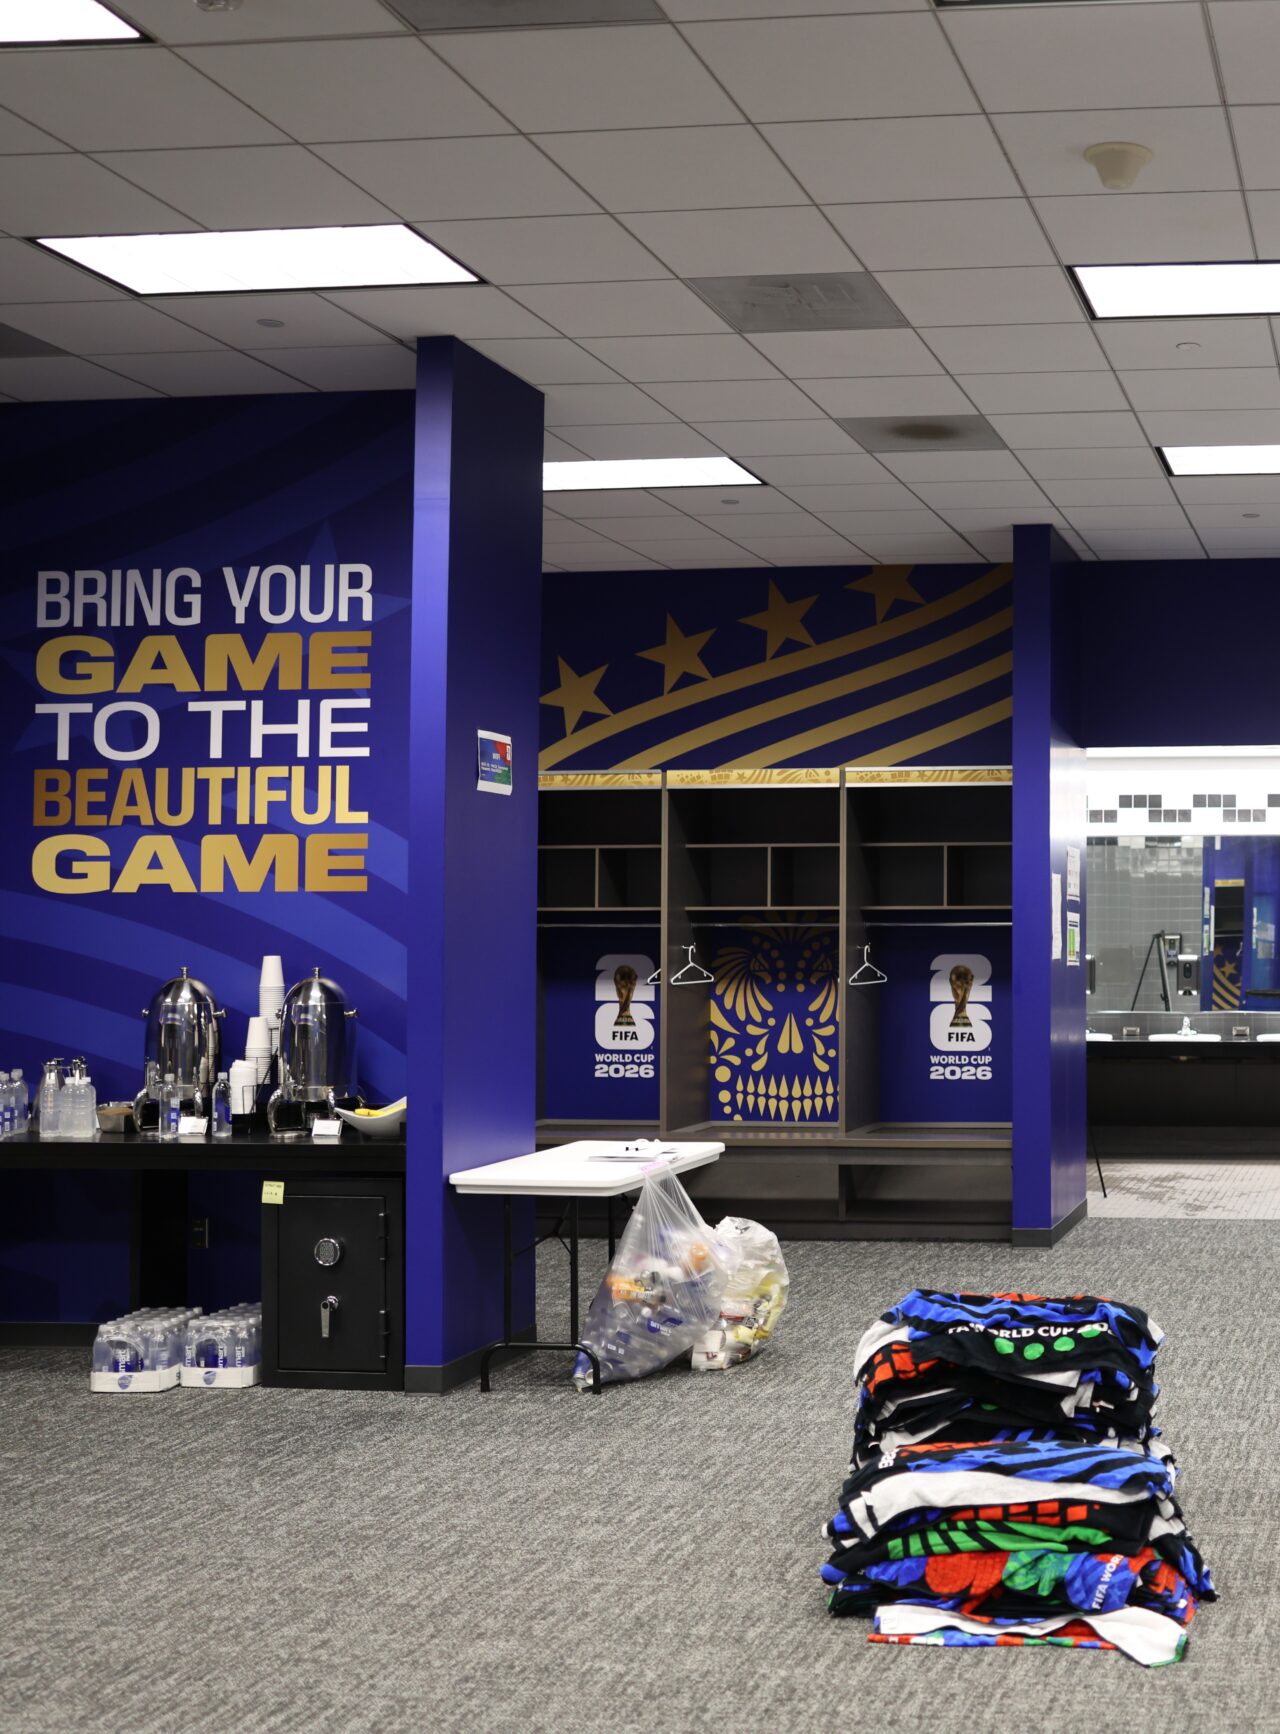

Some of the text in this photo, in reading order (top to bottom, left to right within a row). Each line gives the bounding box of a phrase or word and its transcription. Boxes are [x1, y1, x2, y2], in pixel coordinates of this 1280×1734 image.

[36, 563, 373, 628] BRING YOUR
[35, 630, 372, 695] GAME
[35, 698, 371, 761] TO THE
[33, 765, 369, 827] BEAUTIFUL
[31, 833, 368, 894] GAME
[612, 1031, 639, 1041] FIFA
[948, 1032, 975, 1042] FIFA
[595, 1053, 655, 1062] WORLD CUP
[930, 1055, 992, 1064] WORLD CUP
[594, 1064, 655, 1078] 2026
[930, 1066, 992, 1080] 2026
[1037, 1325, 1075, 1338] CUP
[1092, 1584, 1108, 1610] FIFA
